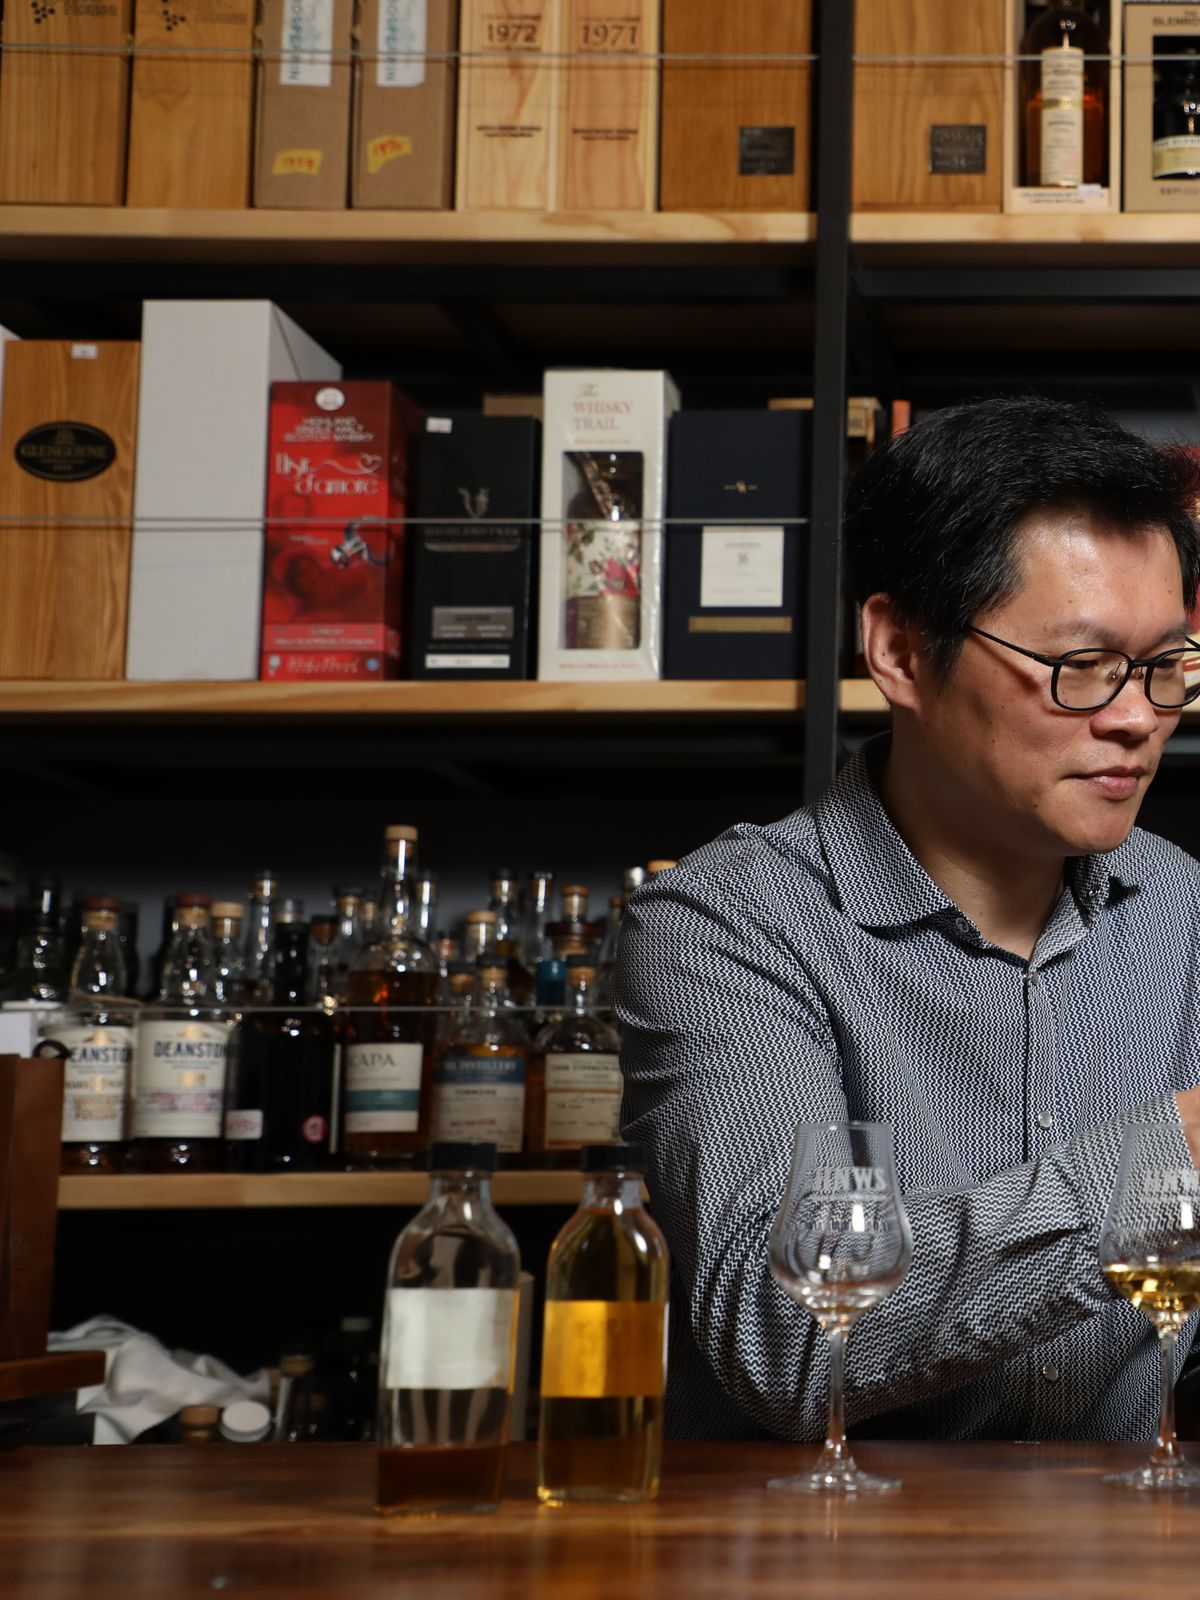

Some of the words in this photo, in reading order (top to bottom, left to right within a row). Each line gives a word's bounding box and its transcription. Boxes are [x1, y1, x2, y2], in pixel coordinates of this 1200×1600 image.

[487, 23, 538, 43] 1972
[582, 23, 638, 47] 1971
[573, 400, 633, 415] WHISKY
[573, 416, 619, 431] TRAIL
